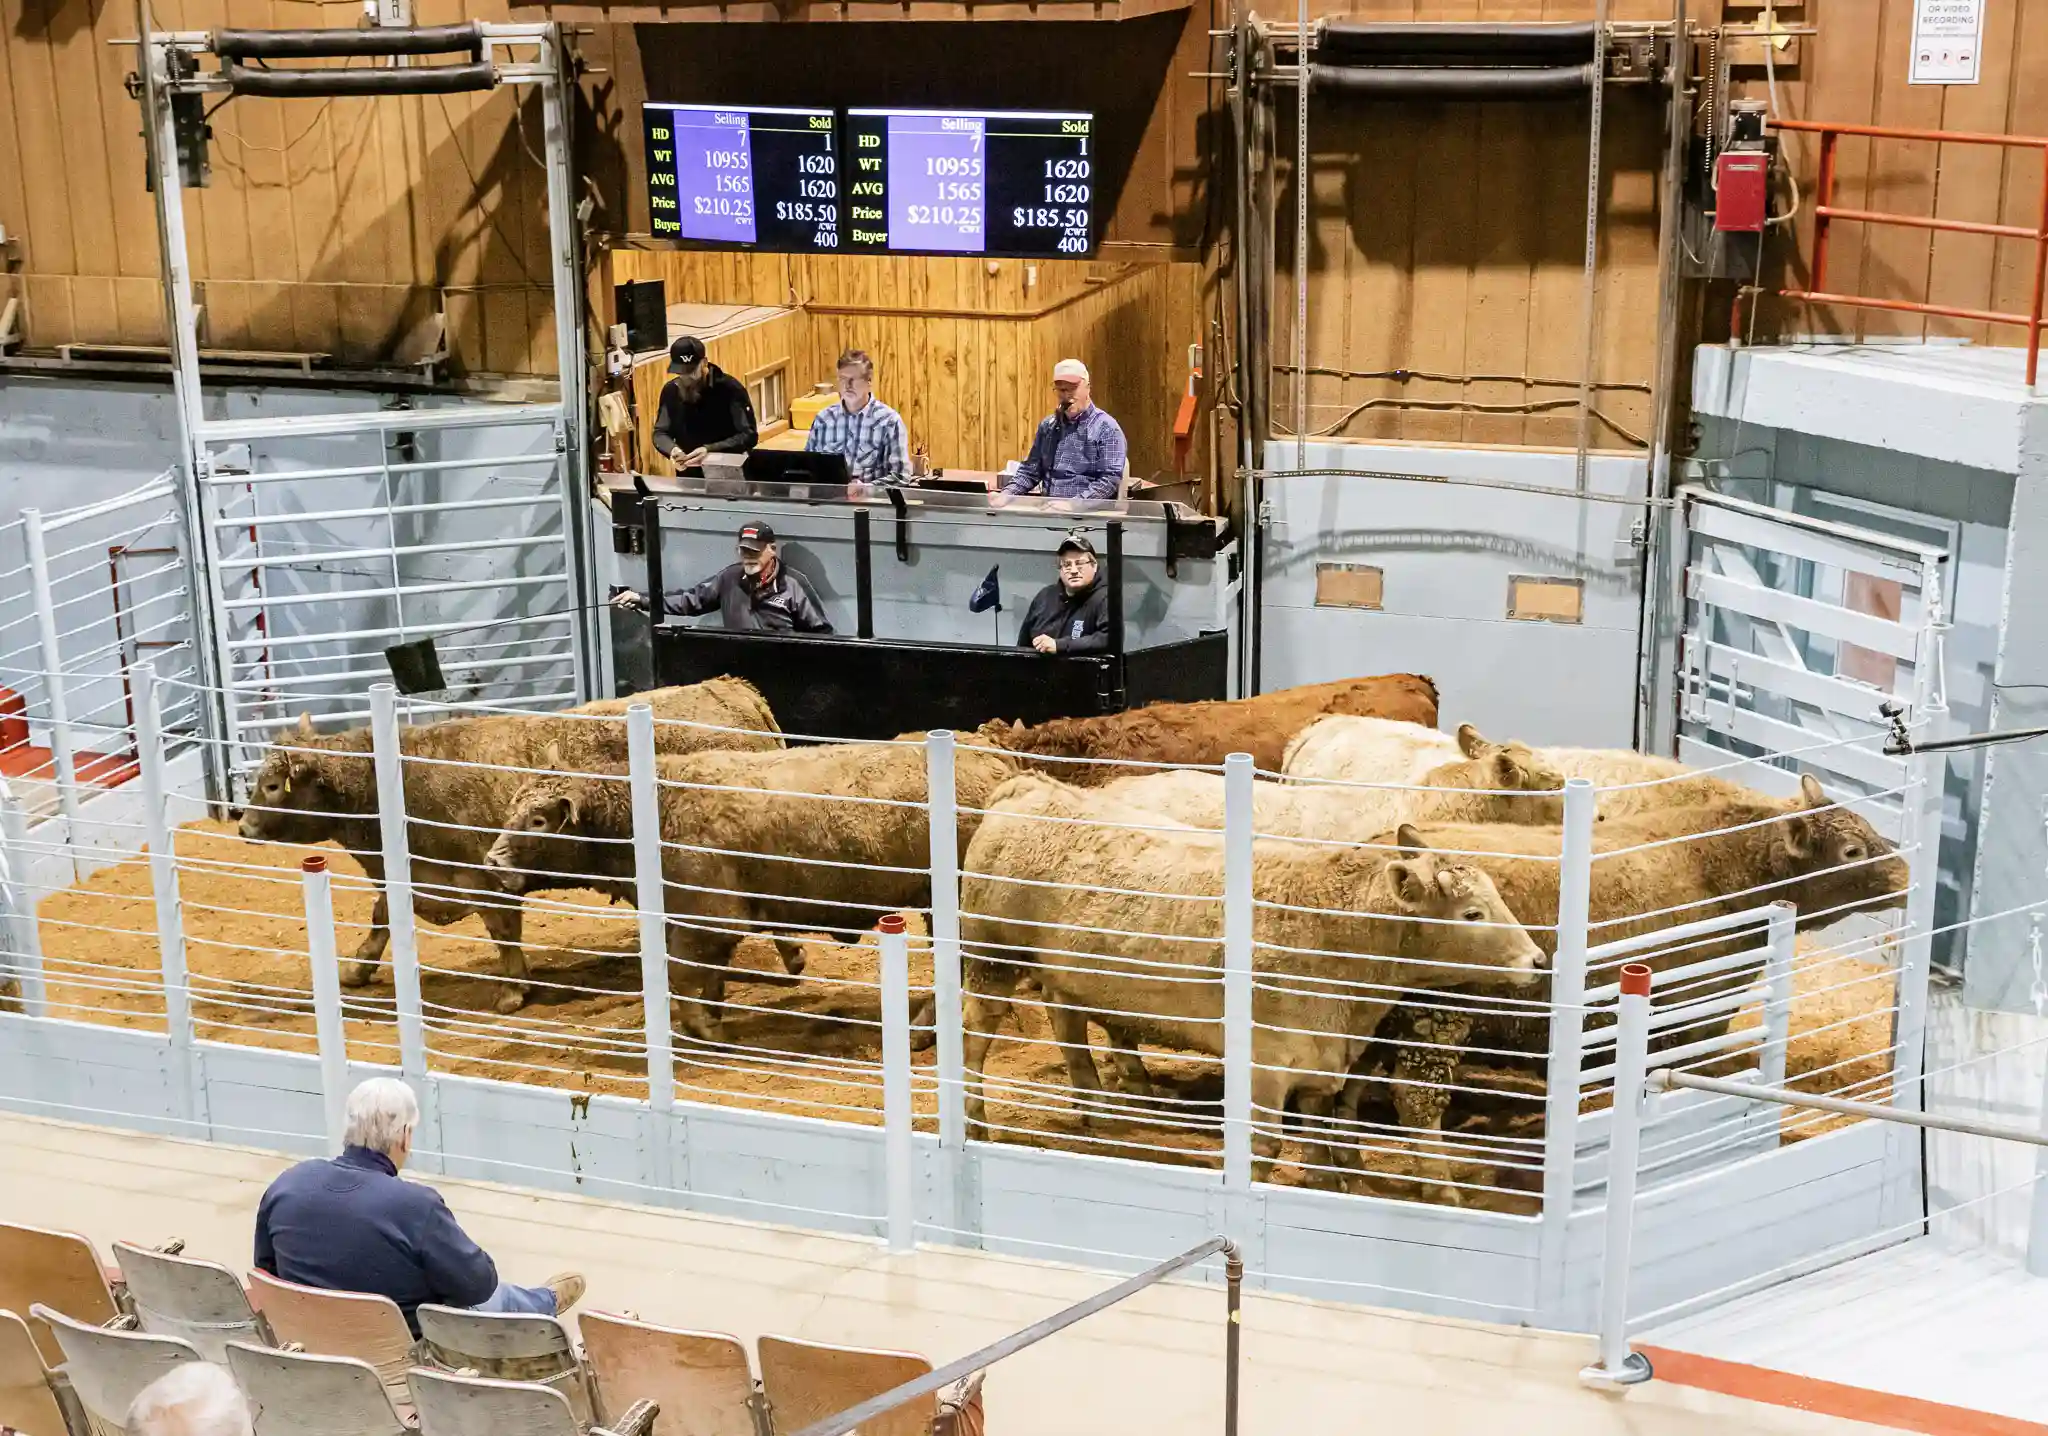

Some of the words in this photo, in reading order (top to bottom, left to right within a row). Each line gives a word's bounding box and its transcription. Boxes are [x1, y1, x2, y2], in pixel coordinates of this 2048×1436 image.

[1922, 16, 1974, 24] RECORDING
[1928, 5, 1941, 13] OR
[1943, 5, 1970, 13] VIDEO
[714, 113, 746, 127] Selling
[809, 116, 832, 129] Sold
[942, 118, 982, 133] Selling
[1062, 121, 1089, 133] Sold
[652, 128, 670, 140] HD
[737, 131, 746, 147] 7
[824, 134, 832, 151] 1
[858, 135, 880, 147] HD
[970, 135, 982, 153] 7
[1079, 138, 1087, 155] 1
[654, 150, 672, 162] WT
[705, 151, 748, 169] 10955
[798, 155, 835, 174] 1620
[859, 158, 882, 171] WT
[926, 157, 981, 176] 10955
[1045, 160, 1089, 179] 1620
[651, 174, 675, 185] AVG
[715, 175, 750, 193] 1565
[799, 179, 836, 198] 1620
[852, 183, 883, 195] AVG
[938, 182, 981, 201] 1565
[1045, 185, 1089, 204] 1620
[652, 197, 676, 209] Price
[694, 197, 751, 216] $210.25
[776, 201, 837, 222] $185.50
[852, 207, 882, 219] Price
[908, 206, 981, 225] $210.25
[1013, 207, 1088, 228] $185.50
[654, 219, 681, 232] Buyer
[814, 232, 838, 247] 400
[853, 230, 888, 244] Buyer
[1058, 237, 1088, 253] 400
